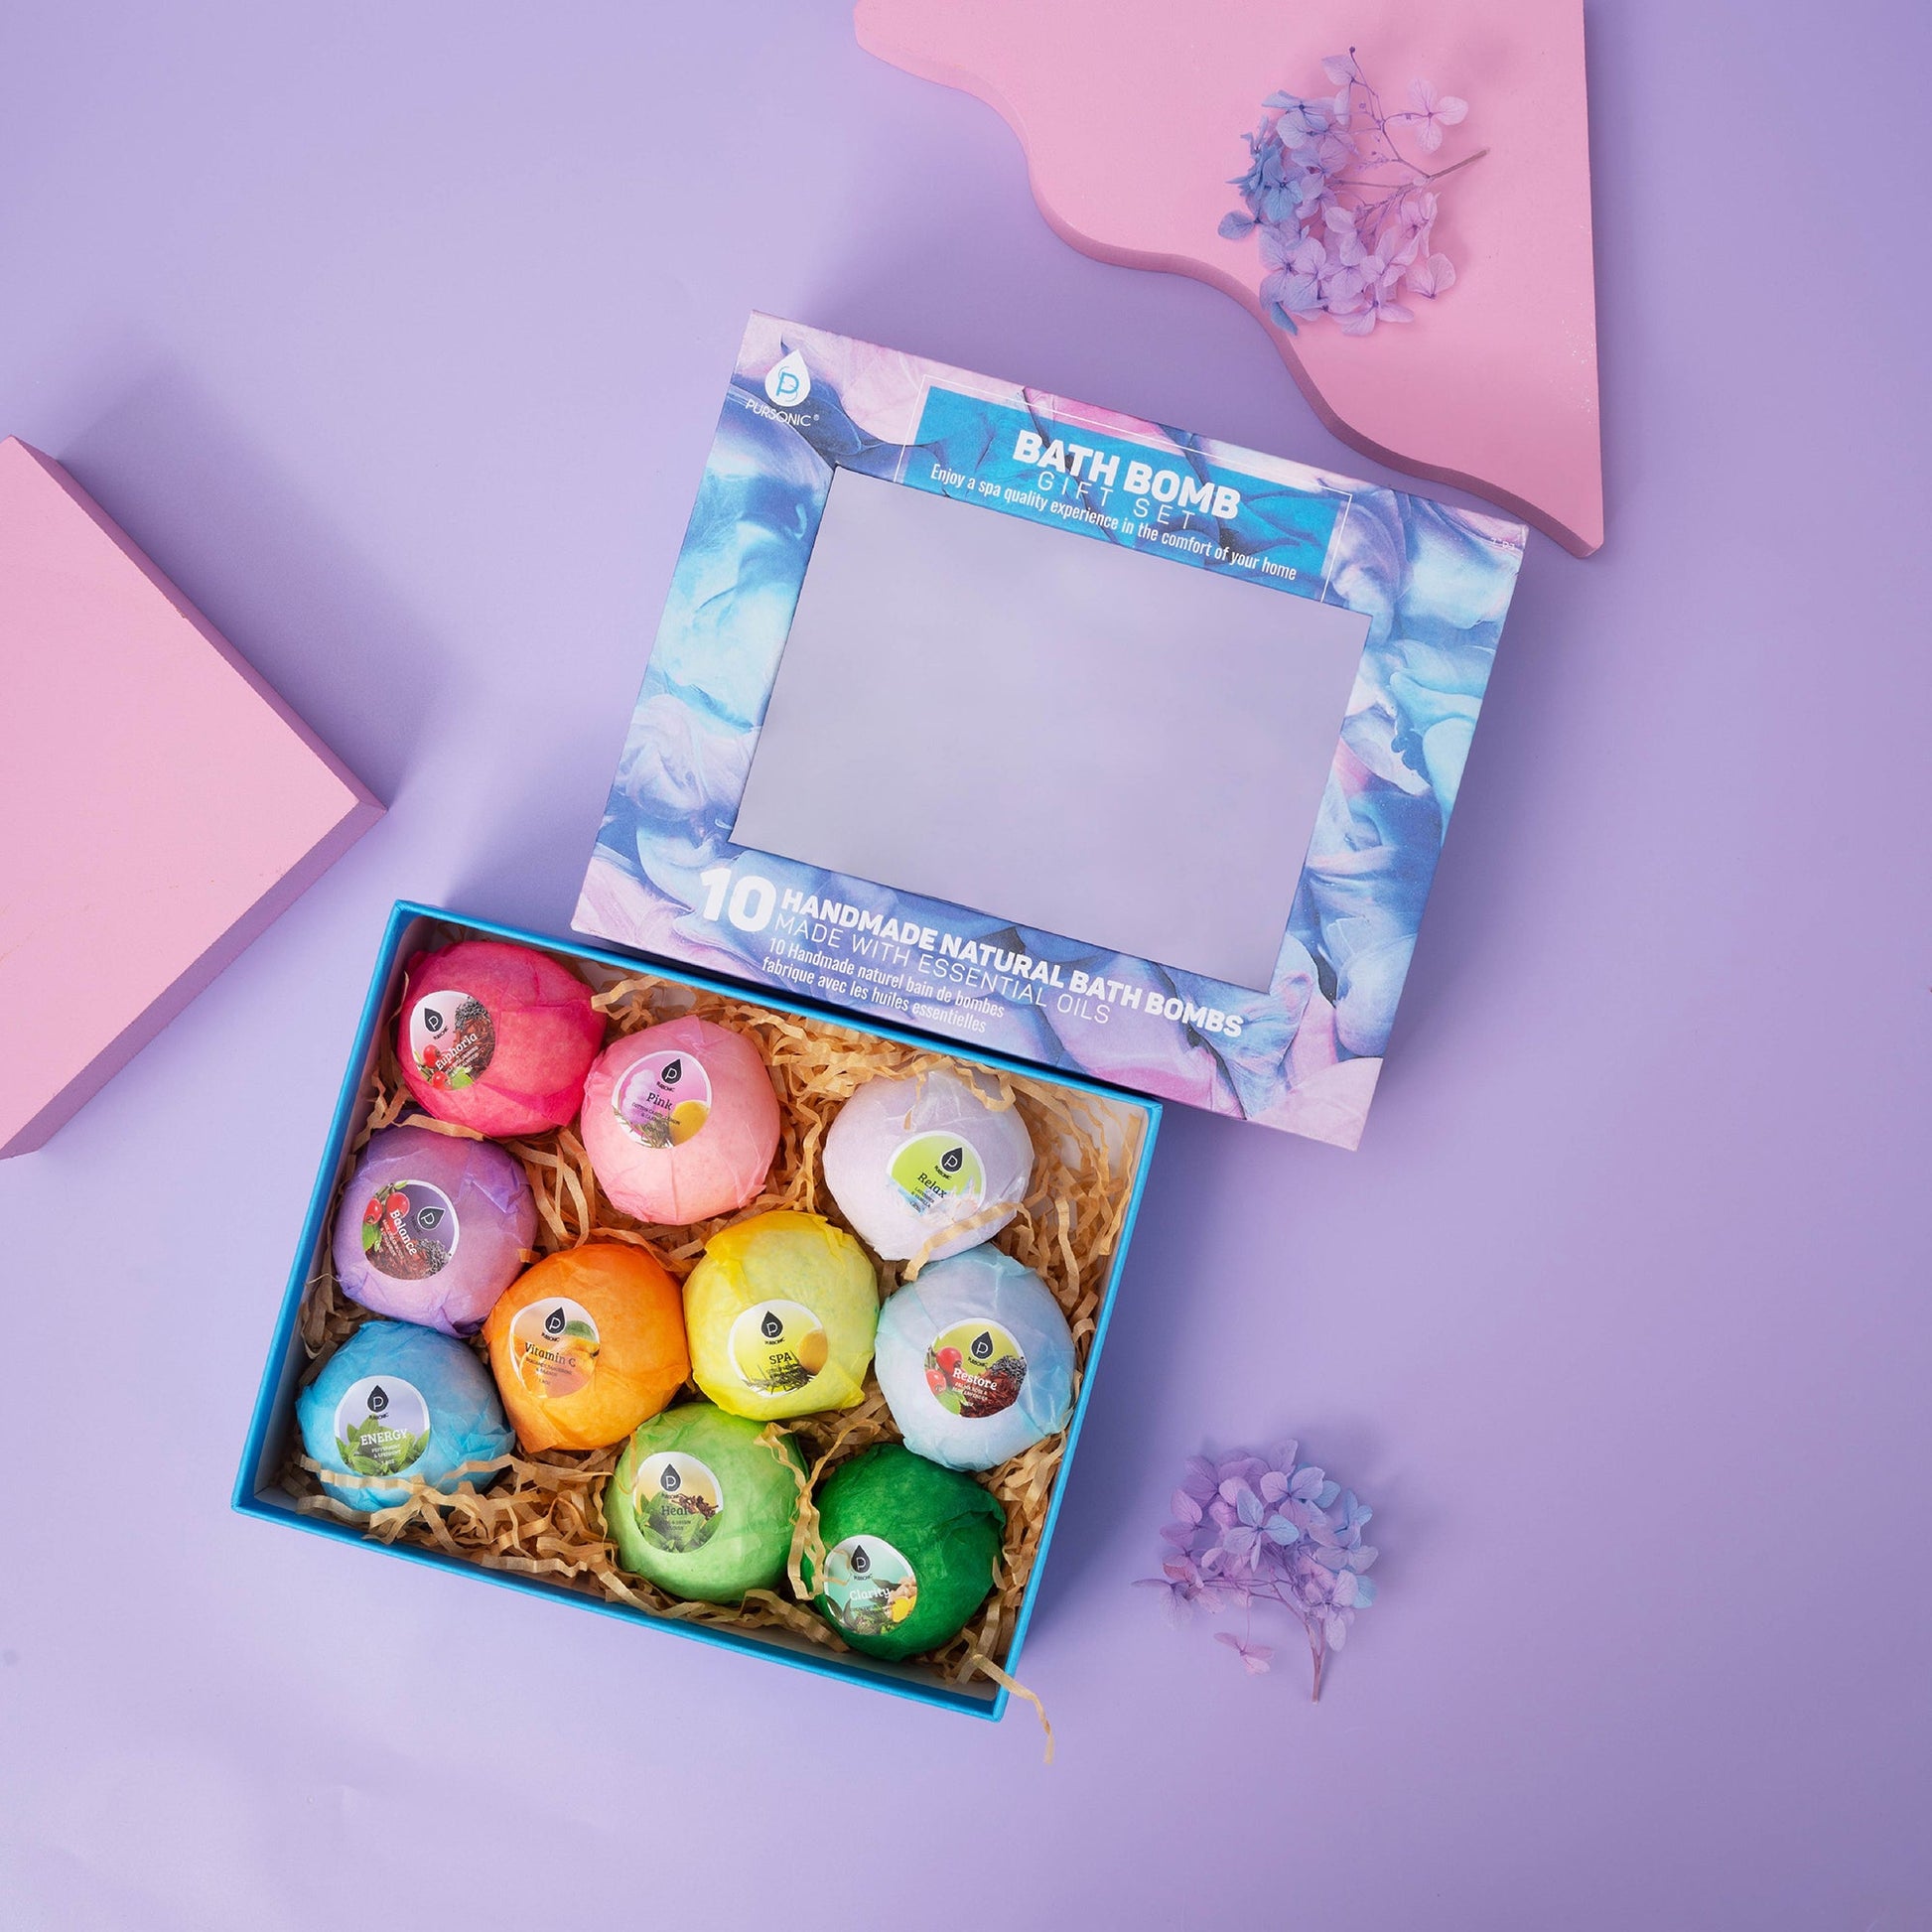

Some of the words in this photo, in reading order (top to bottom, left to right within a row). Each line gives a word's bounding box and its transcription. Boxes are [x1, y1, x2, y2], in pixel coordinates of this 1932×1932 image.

[1013, 429, 1121, 486] BATH
[1123, 461, 1240, 519] BOMB
[1037, 472, 1113, 506] GIFT
[1133, 497, 1195, 530] SET
[930, 464, 965, 488] Enjoy
[967, 478, 976, 489] a
[978, 481, 1001, 500] spa
[1004, 487, 1048, 511] quality
[1050, 500, 1119, 530] experience
[1121, 517, 1135, 534] in
[1138, 520, 1159, 541] the
[1161, 532, 1212, 557] comfort
[1214, 546, 1230, 561] of
[1229, 551, 1260, 566] your
[1261, 556, 1298, 581] home
[700, 867, 776, 932] 10
[769, 937, 785, 955] 10
[787, 943, 855, 975] Handmade
[857, 965, 904, 989] naturel
[905, 977, 934, 997] bain
[936, 986, 951, 1003] de
[955, 992, 1005, 1019] bombes
[774, 913, 844, 948] MADE
[852, 933, 910, 967] WITH
[918, 954, 1047, 1008] ESSENTIAL
[1057, 993, 1111, 1024] OILS
[781, 889, 938, 951] HANDMADE
[939, 933, 1064, 989] NATURAL
[1068, 969, 1143, 1010] BATH
[1144, 991, 1244, 1037] BOMBS
[761, 956, 815, 985] fabrique
[817, 975, 847, 993] avec
[849, 981, 868, 1000] les
[871, 987, 909, 1012] huiles
[911, 1002, 987, 1034] essentielles
[435, 1033, 478, 1070] Euphoria
[646, 1092, 673, 1111] Pink
[917, 1173, 947, 1198] Relax
[390, 1208, 418, 1256] Balance
[524, 1342, 565, 1365] Vitamin
[569, 1357, 577, 1367] C
[768, 1352, 792, 1365] SPA
[953, 1367, 998, 1390] Restore
[360, 1429, 408, 1446] ENERGY
[661, 1505, 688, 1515] Heal
[849, 1587, 891, 1601] Clarity
